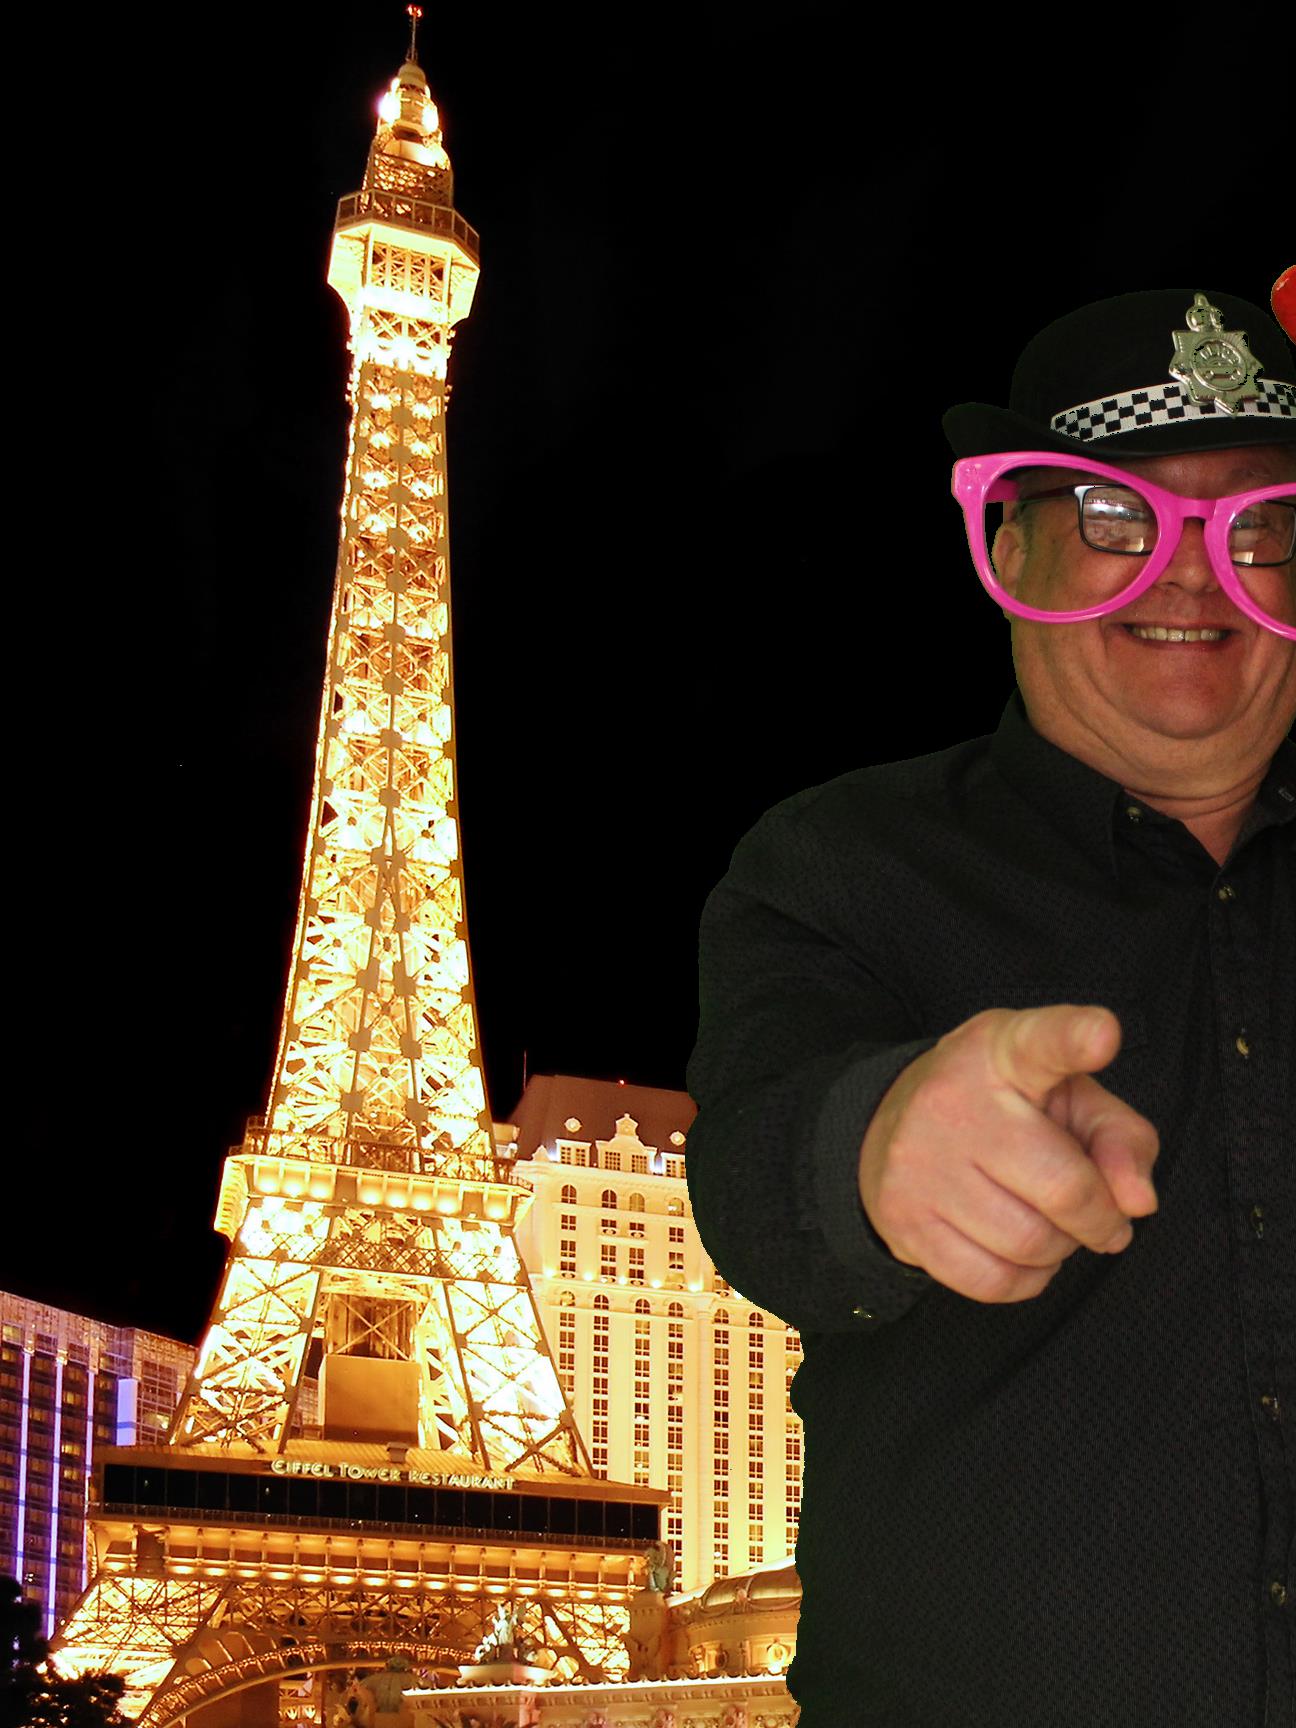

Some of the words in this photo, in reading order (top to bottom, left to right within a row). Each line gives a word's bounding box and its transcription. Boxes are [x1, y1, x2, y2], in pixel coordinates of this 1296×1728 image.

[271, 1459, 334, 1477] EIFFEL
[338, 1462, 401, 1482] TOWER
[408, 1469, 515, 1490] RESTAURANT
